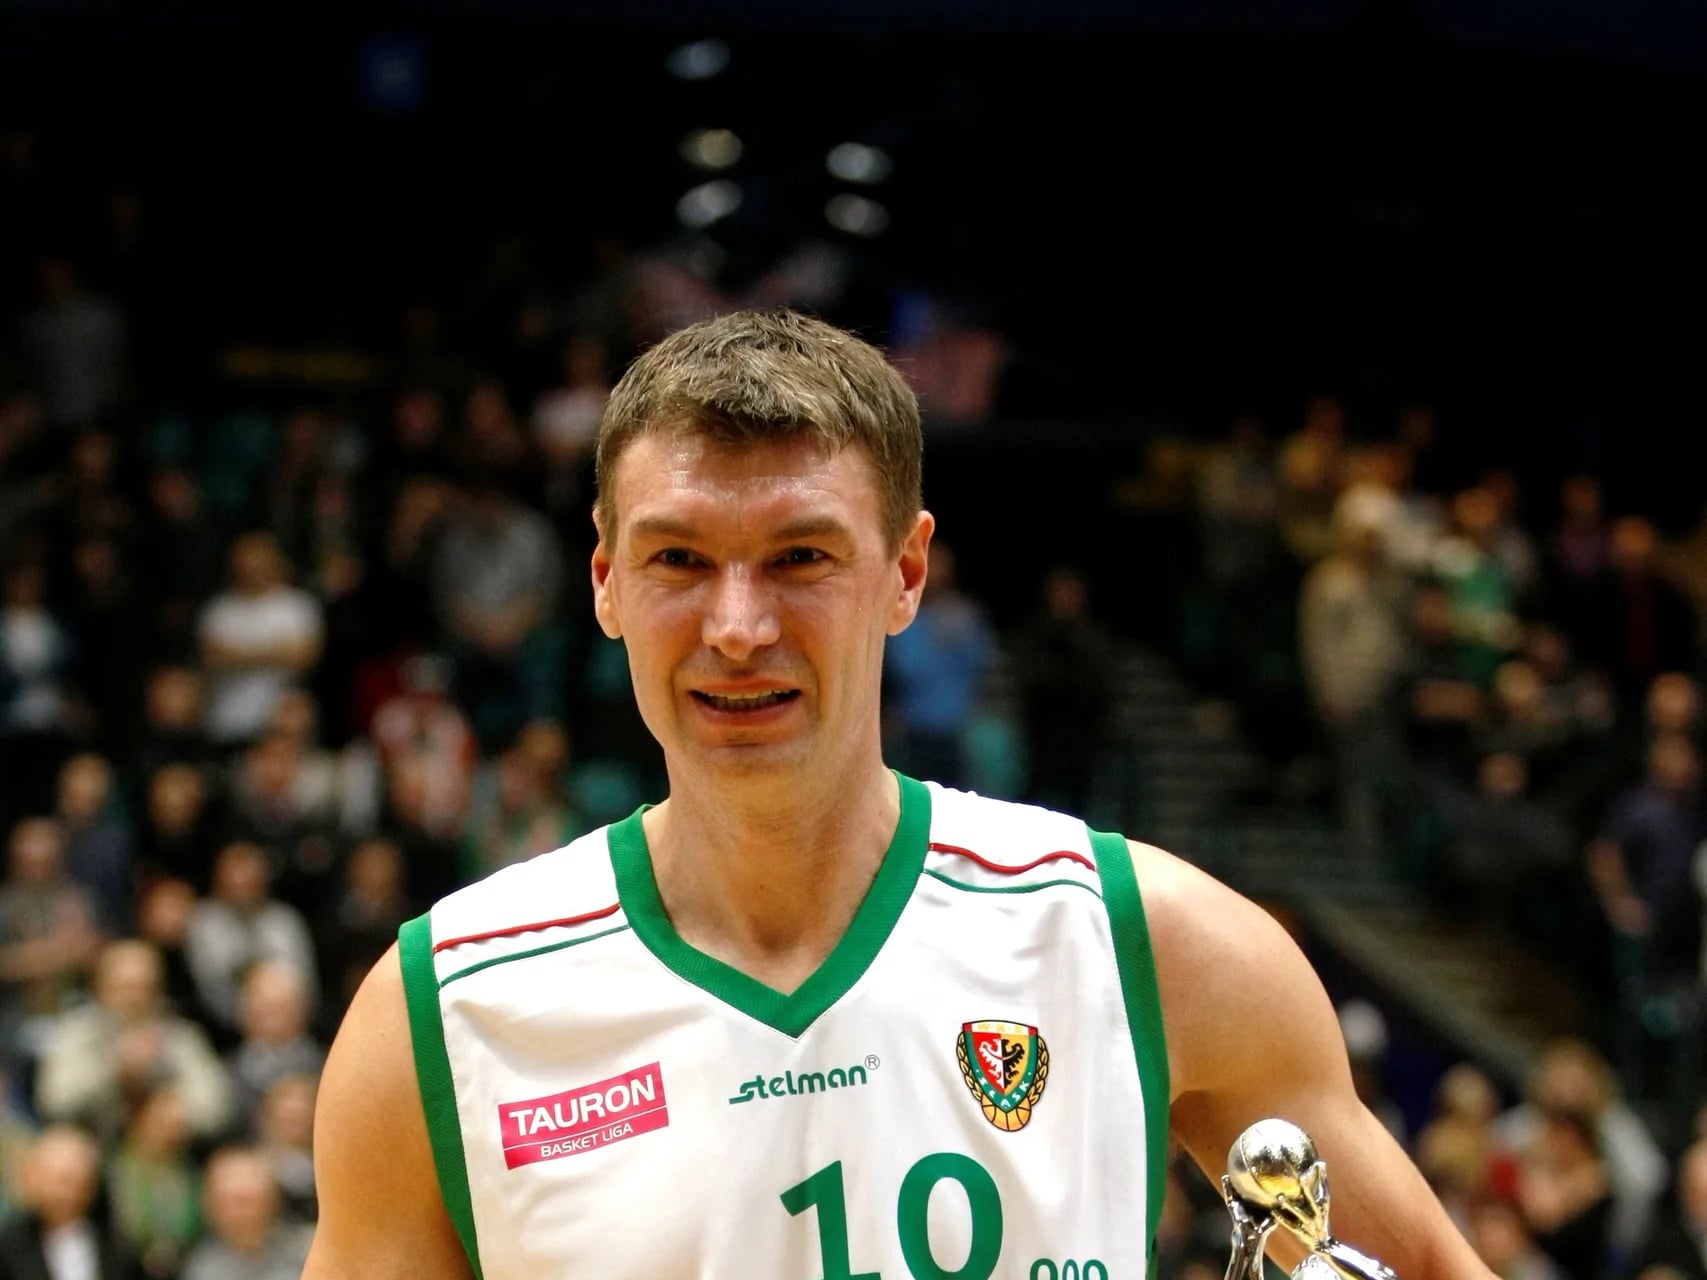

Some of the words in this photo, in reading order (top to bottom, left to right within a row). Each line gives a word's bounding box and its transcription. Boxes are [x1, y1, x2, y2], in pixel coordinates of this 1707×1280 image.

[508, 1073, 657, 1137] TAURON
[540, 1133, 599, 1158] BASKET
[602, 1122, 634, 1142] LIGA
